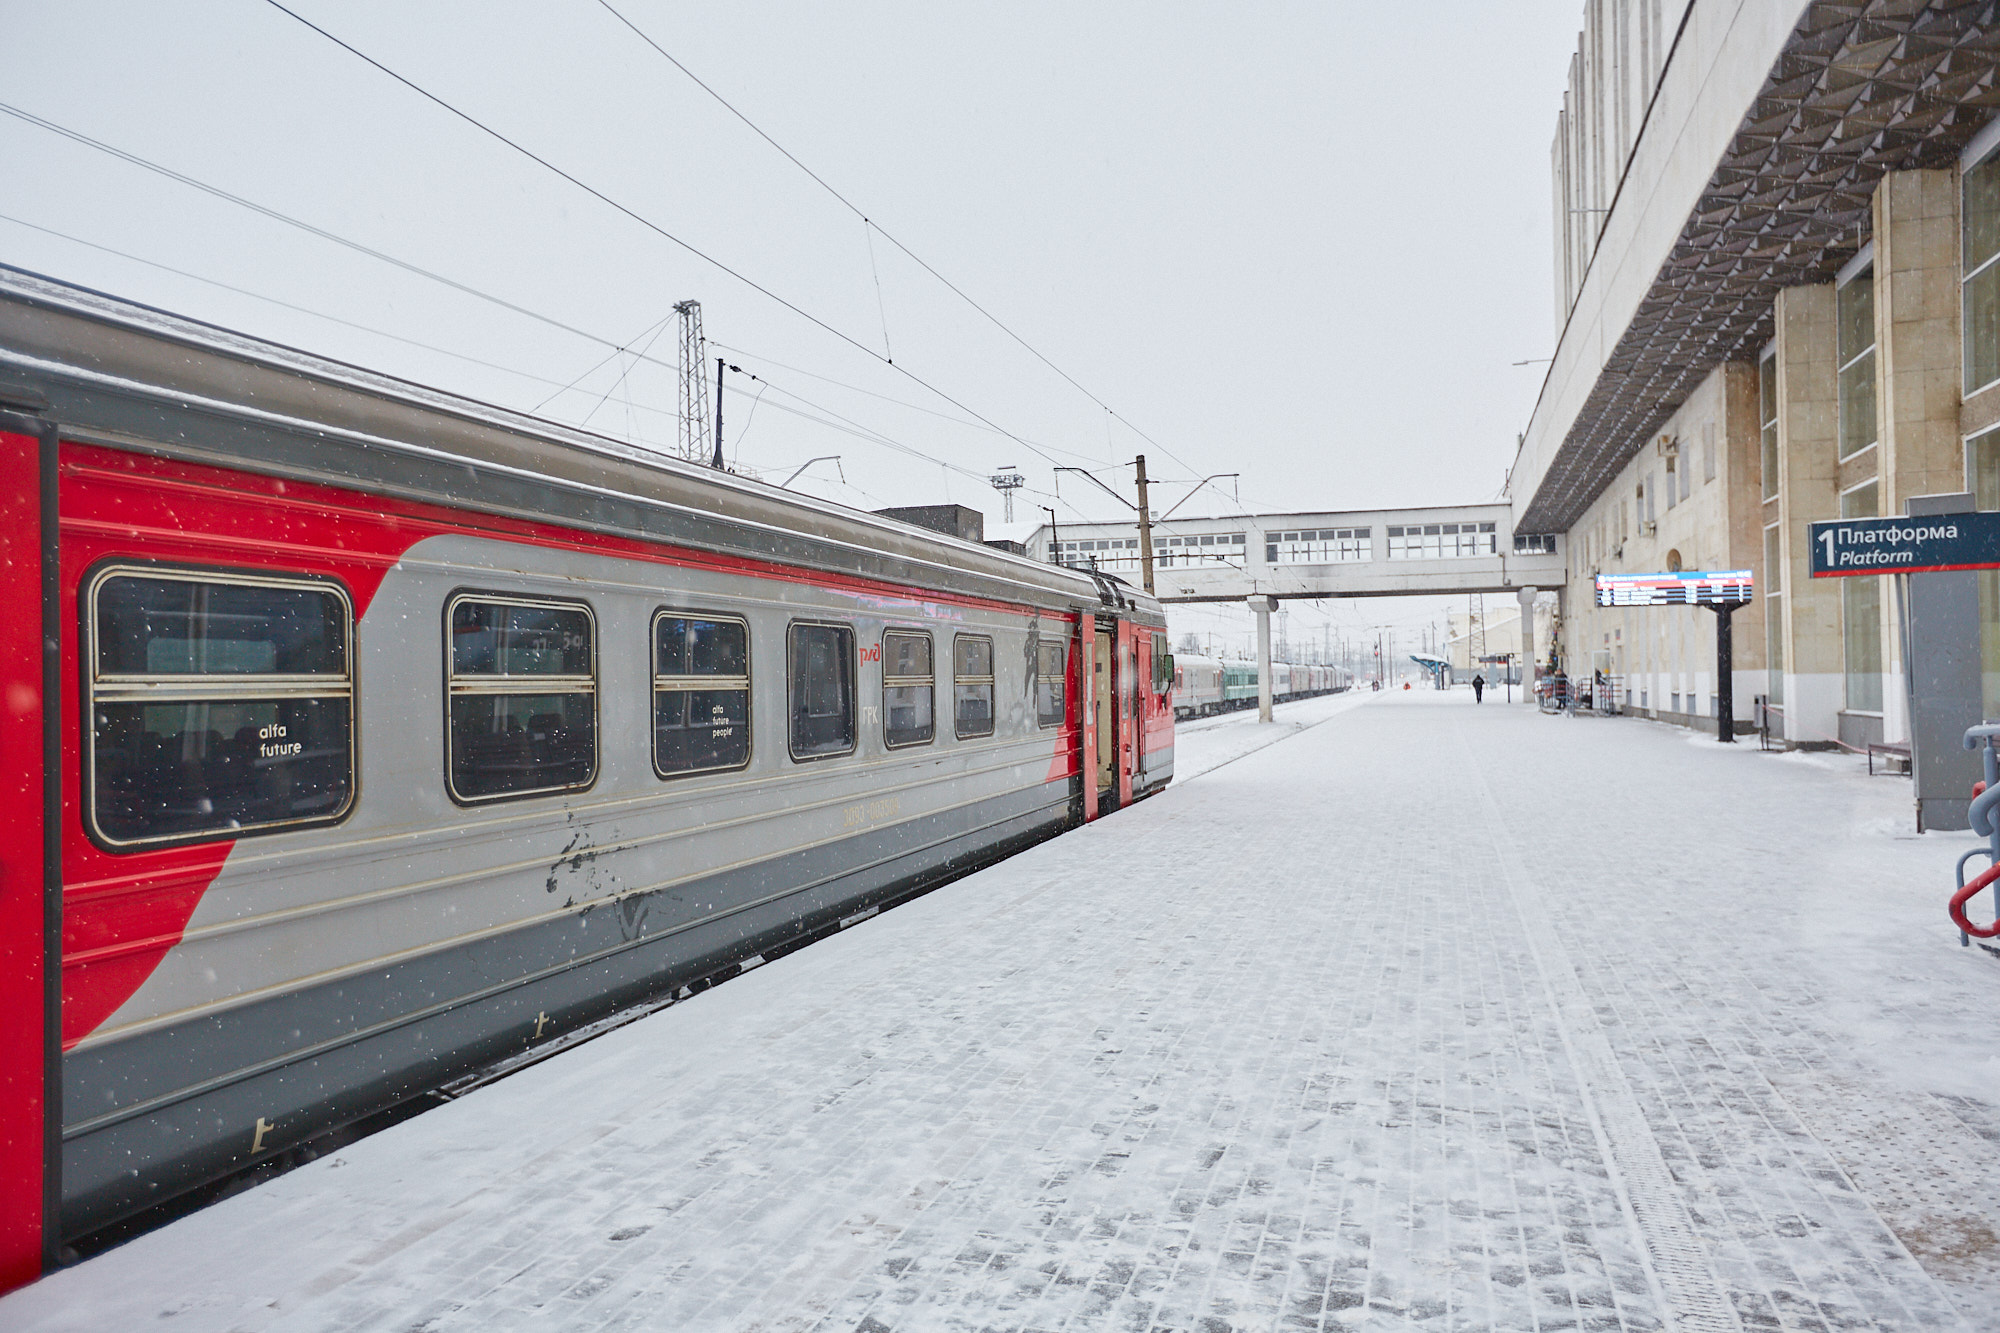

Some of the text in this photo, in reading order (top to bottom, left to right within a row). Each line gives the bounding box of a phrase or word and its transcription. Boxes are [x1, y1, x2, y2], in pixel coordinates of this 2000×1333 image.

[1838, 525, 1958, 546] Платформа
[1817, 529, 1835, 567] 1
[1839, 549, 1913, 566] Platform
[712, 704, 724, 714] alfa
[863, 705, 878, 724] ГРК
[712, 716, 730, 726] future
[259, 723, 287, 739] alfa
[712, 727, 732, 739] people
[260, 742, 302, 758] future
